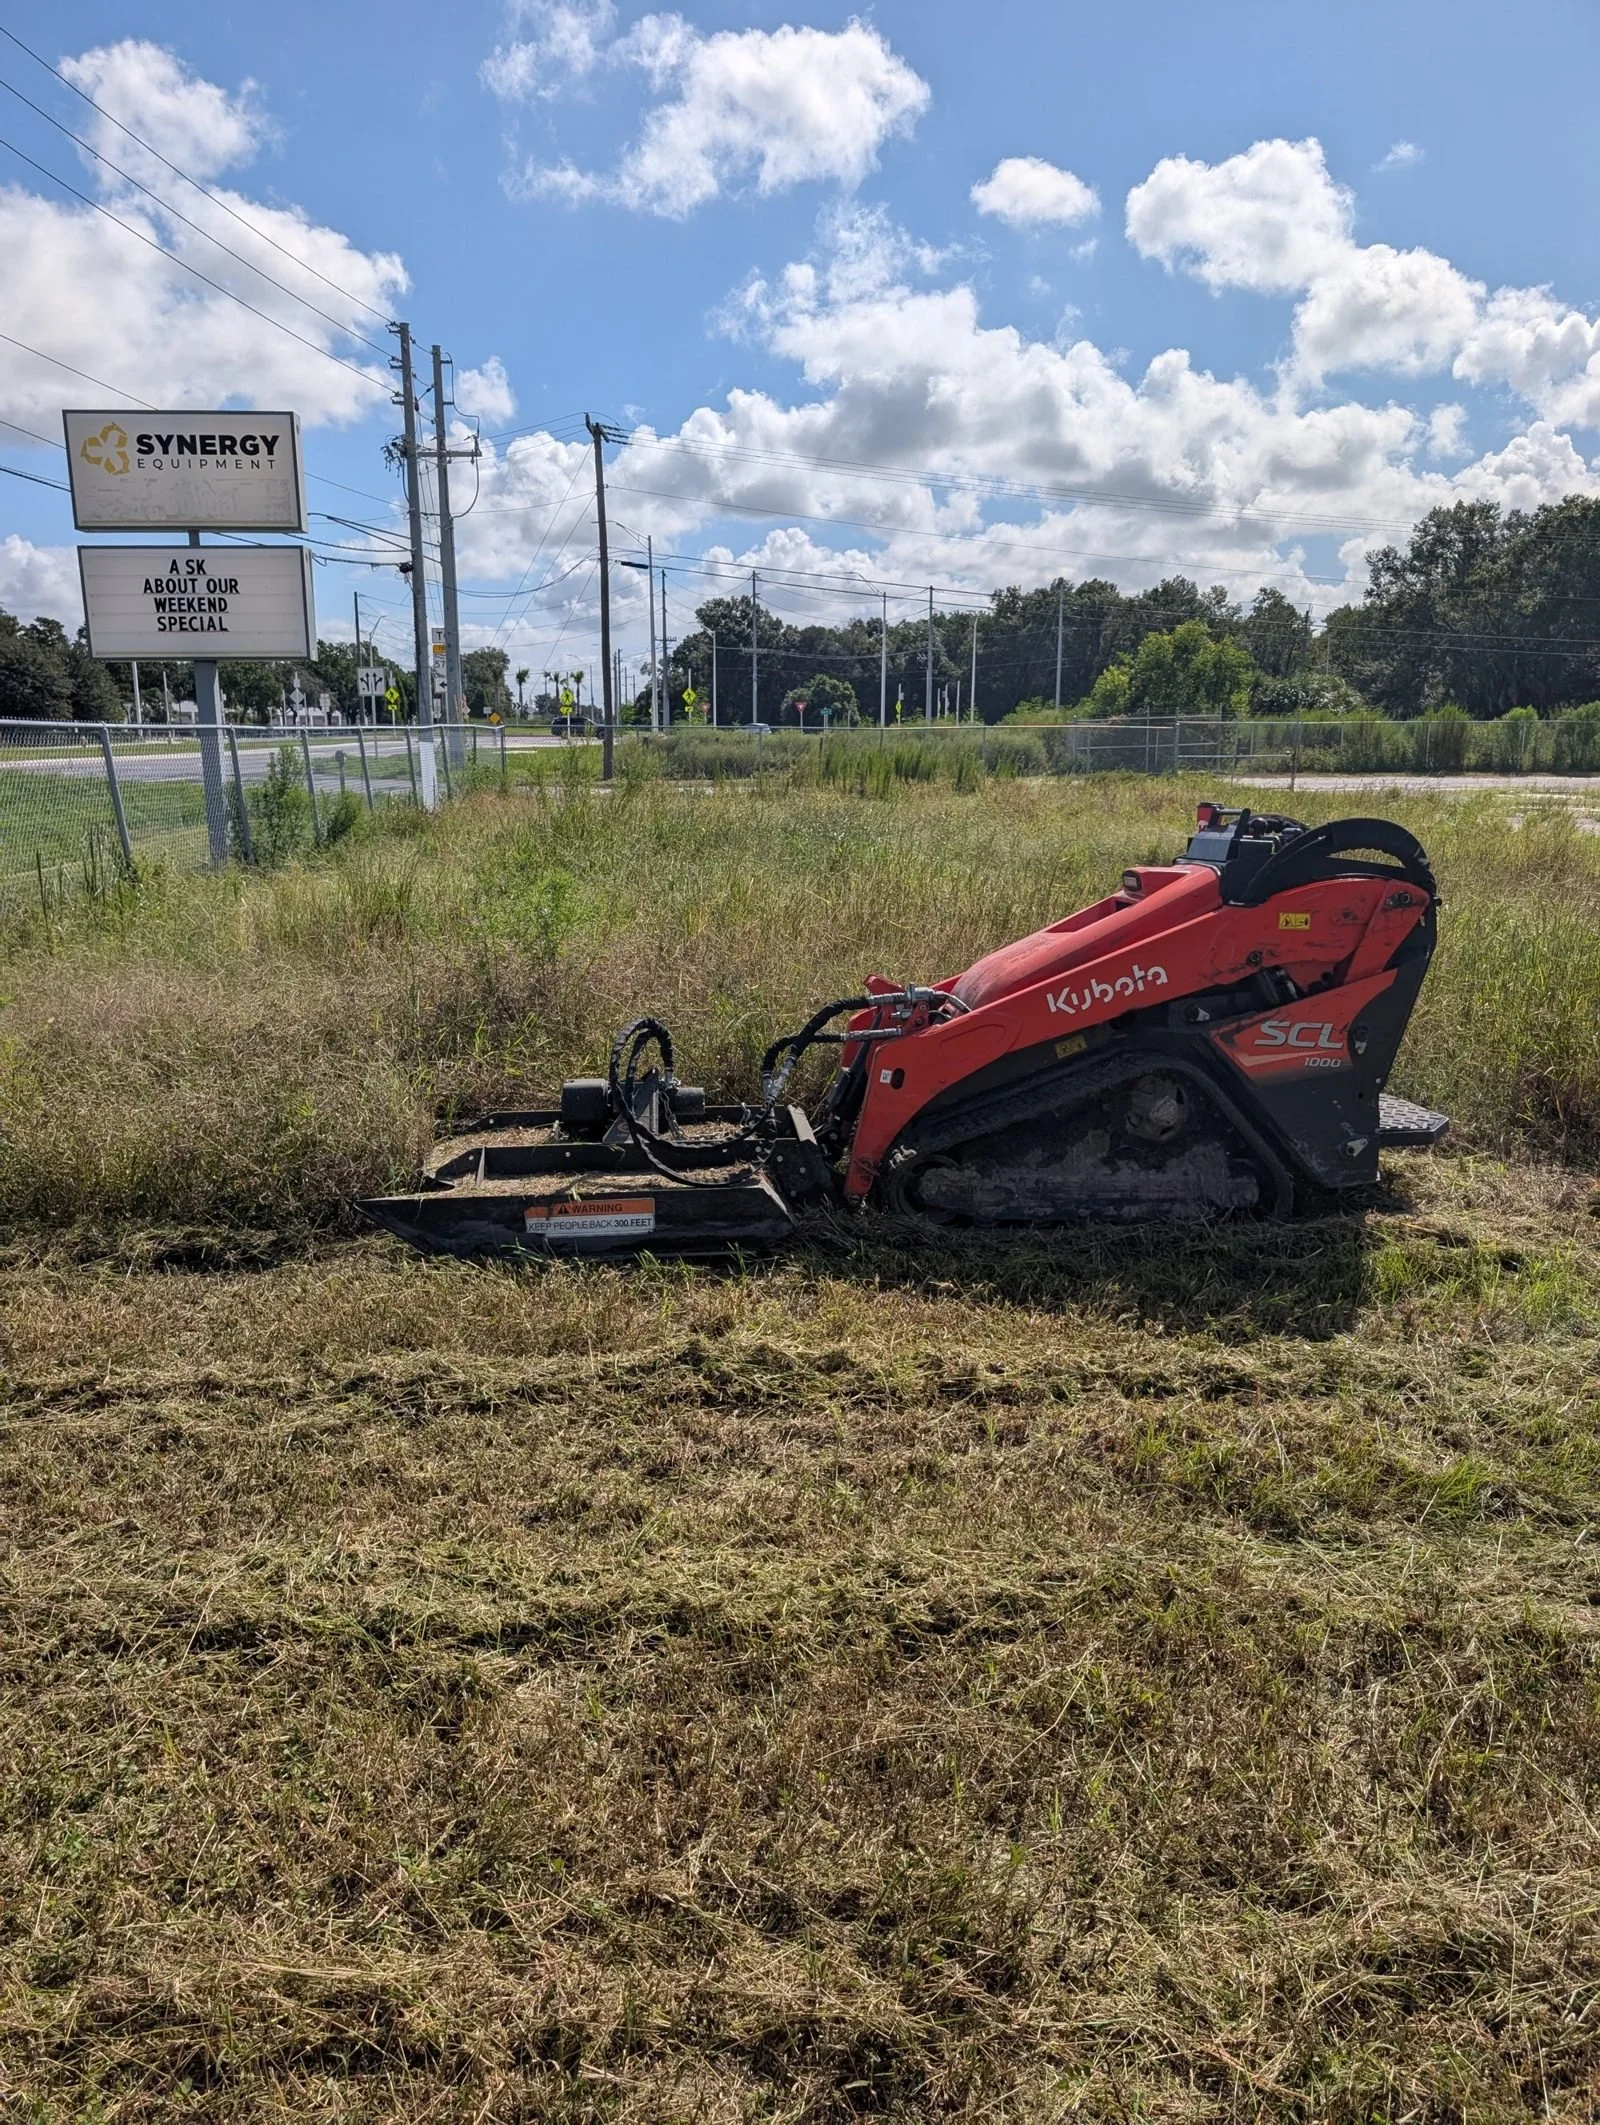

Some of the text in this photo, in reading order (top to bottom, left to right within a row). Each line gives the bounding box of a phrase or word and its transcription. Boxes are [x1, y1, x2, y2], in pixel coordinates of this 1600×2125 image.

[136, 433, 280, 456] SYNERGY
[137, 458, 276, 470] EQUIPMENT
[169, 559, 206, 575] ASK
[143, 578, 240, 594] ABOUT OUR
[154, 597, 228, 613] WEEKEND
[157, 616, 229, 631] SPECIAL
[1046, 964, 1168, 1015] Kubota
[1254, 1020, 1343, 1049] SCL
[1304, 1057, 1342, 1068] 1000
[571, 1203, 623, 1214] WARNING
[528, 1218, 652, 1232] KEEP PEOPLE BACK 300 FEET
